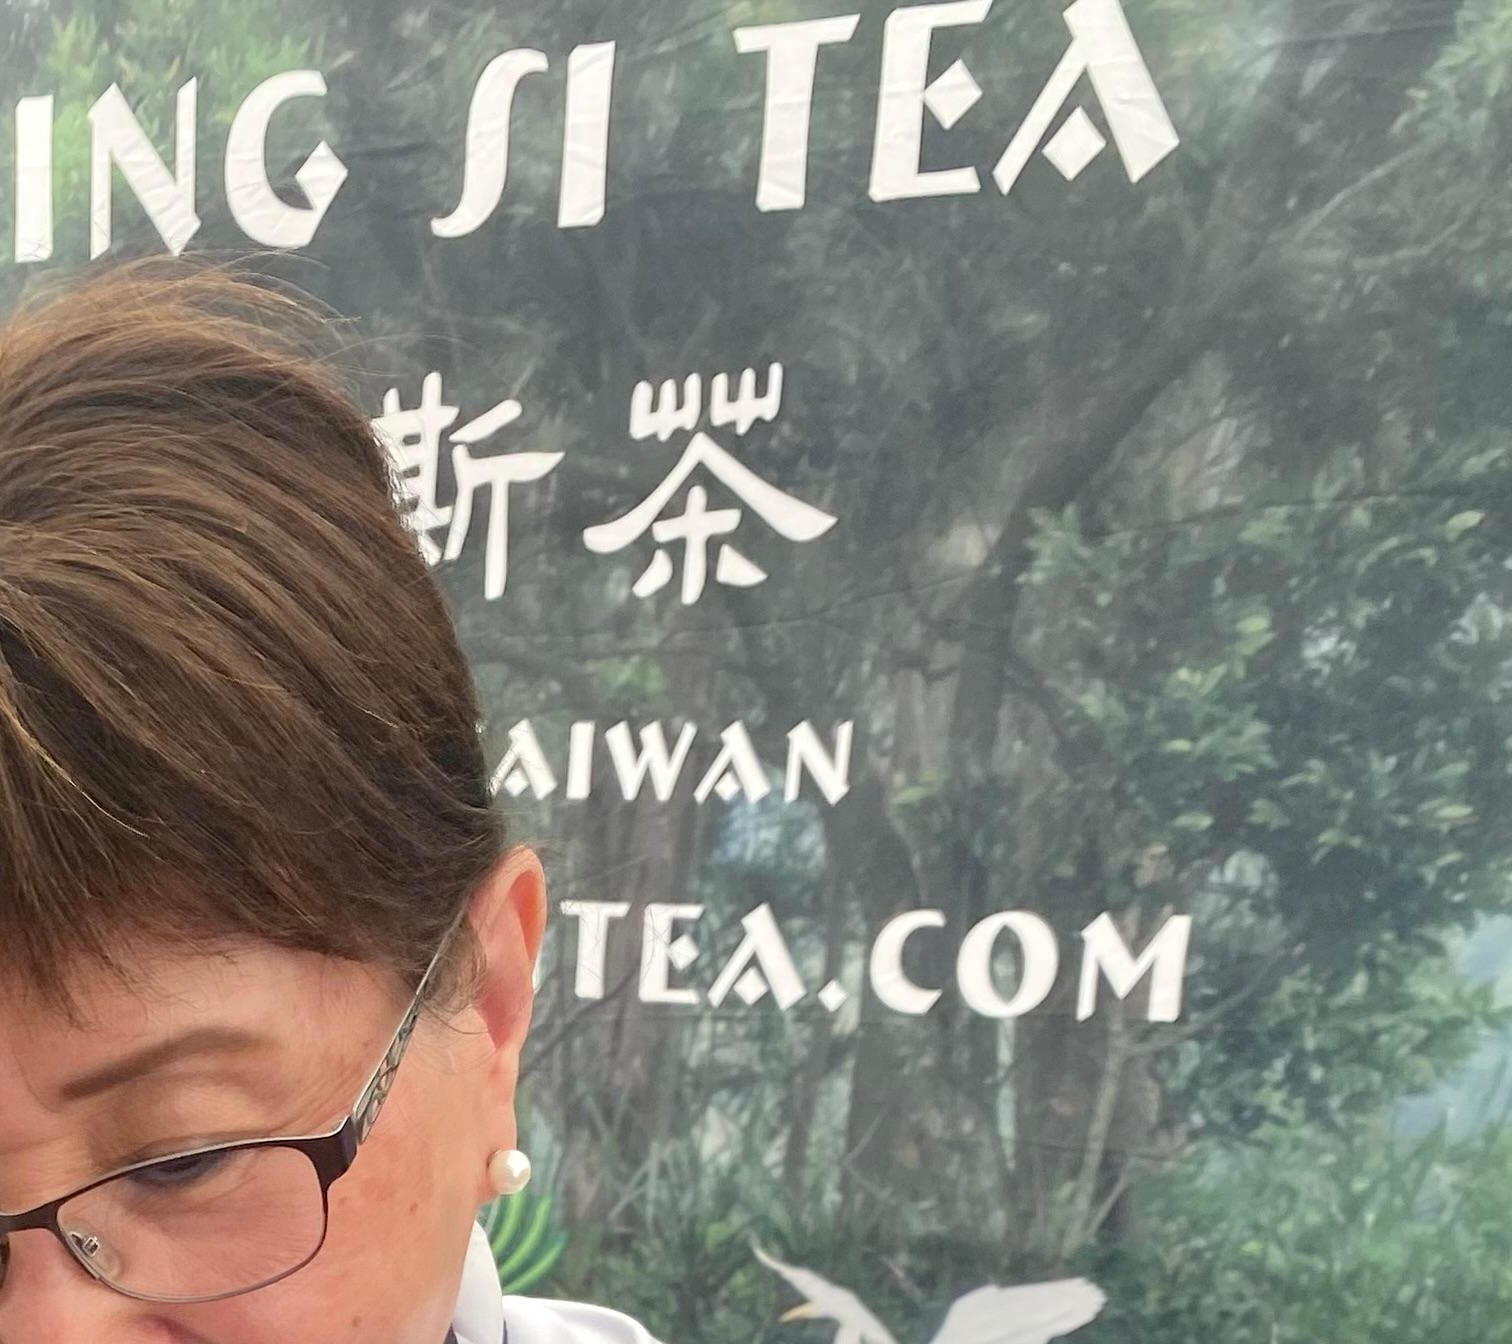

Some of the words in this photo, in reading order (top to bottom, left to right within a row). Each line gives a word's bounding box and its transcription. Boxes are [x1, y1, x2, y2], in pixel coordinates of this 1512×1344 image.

[430, 40, 616, 239] SI
[733, 0, 1180, 212] TEA
[489, 718, 854, 807] AIWAN
[532, 899, 1193, 1023] TEA.COM
